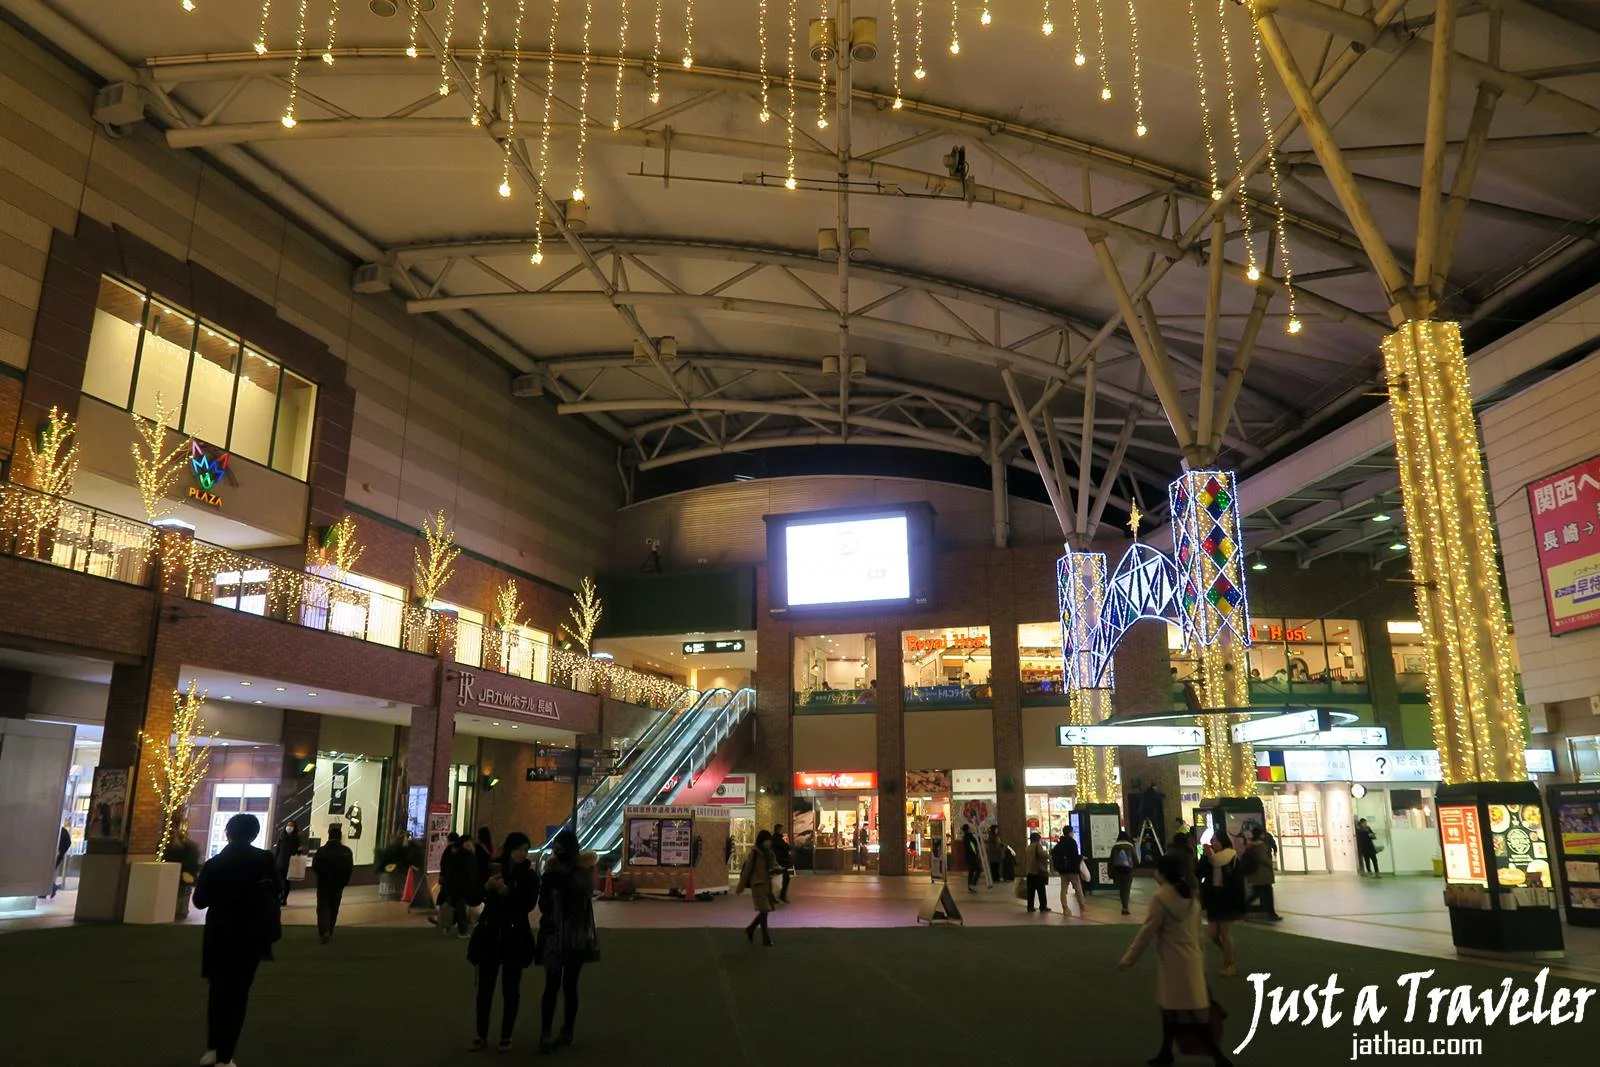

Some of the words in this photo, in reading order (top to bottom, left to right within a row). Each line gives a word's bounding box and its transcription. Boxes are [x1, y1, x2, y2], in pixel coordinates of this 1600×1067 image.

[189, 487, 224, 506] PLAZA
[1534, 474, 1600, 515] 関西へ
[1543, 523, 1580, 551] 長崎
[906, 635, 947, 654] Royal
[954, 633, 987, 649] Host
[1269, 624, 1307, 641] Host
[479, 688, 535, 711] JR九州ホテル
